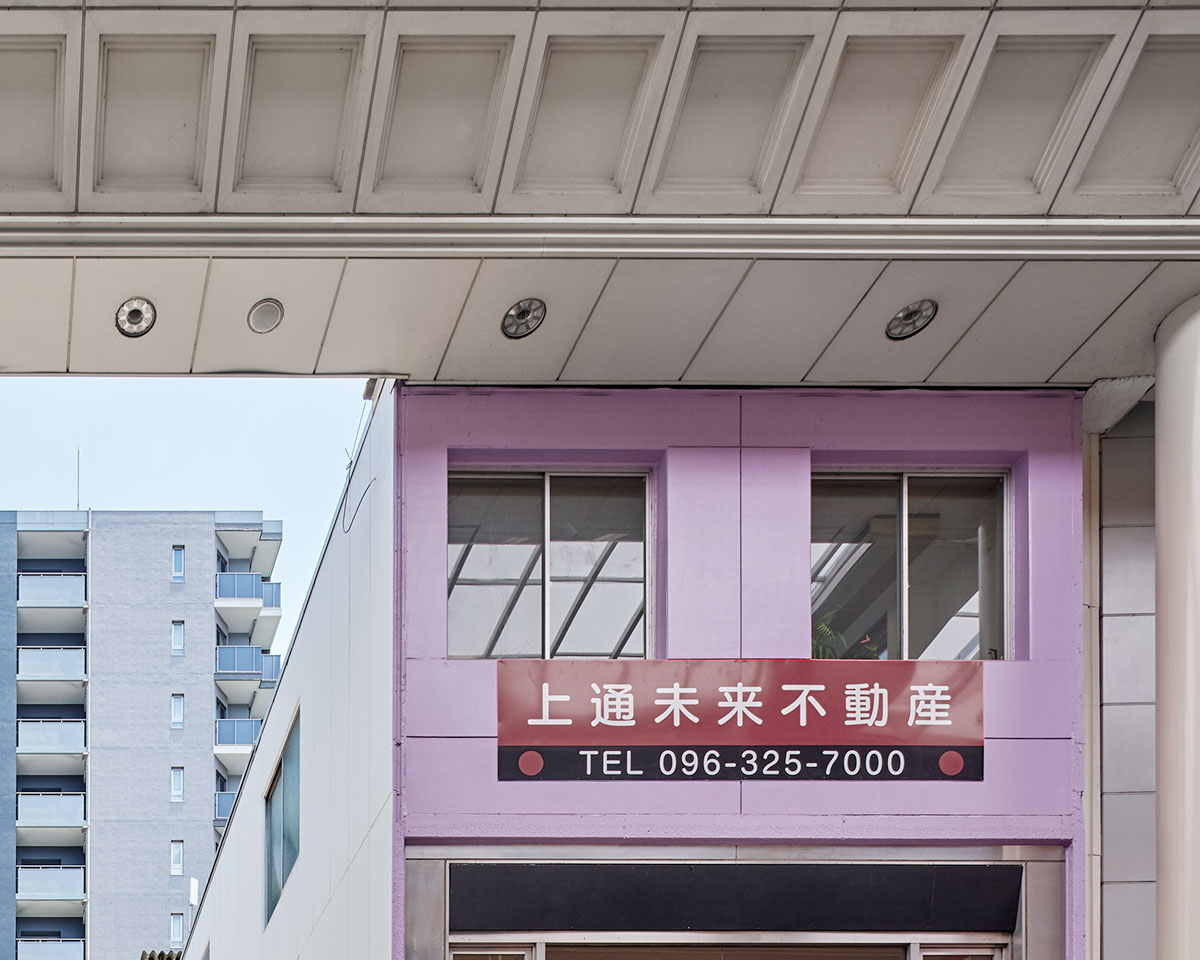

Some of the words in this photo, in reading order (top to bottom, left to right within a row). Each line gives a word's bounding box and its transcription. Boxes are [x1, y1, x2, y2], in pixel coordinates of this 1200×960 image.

[527, 683, 952, 728] 上通未来不動産
[579, 750, 643, 776] TEL
[659, 750, 905, 776] 096-325-7000
